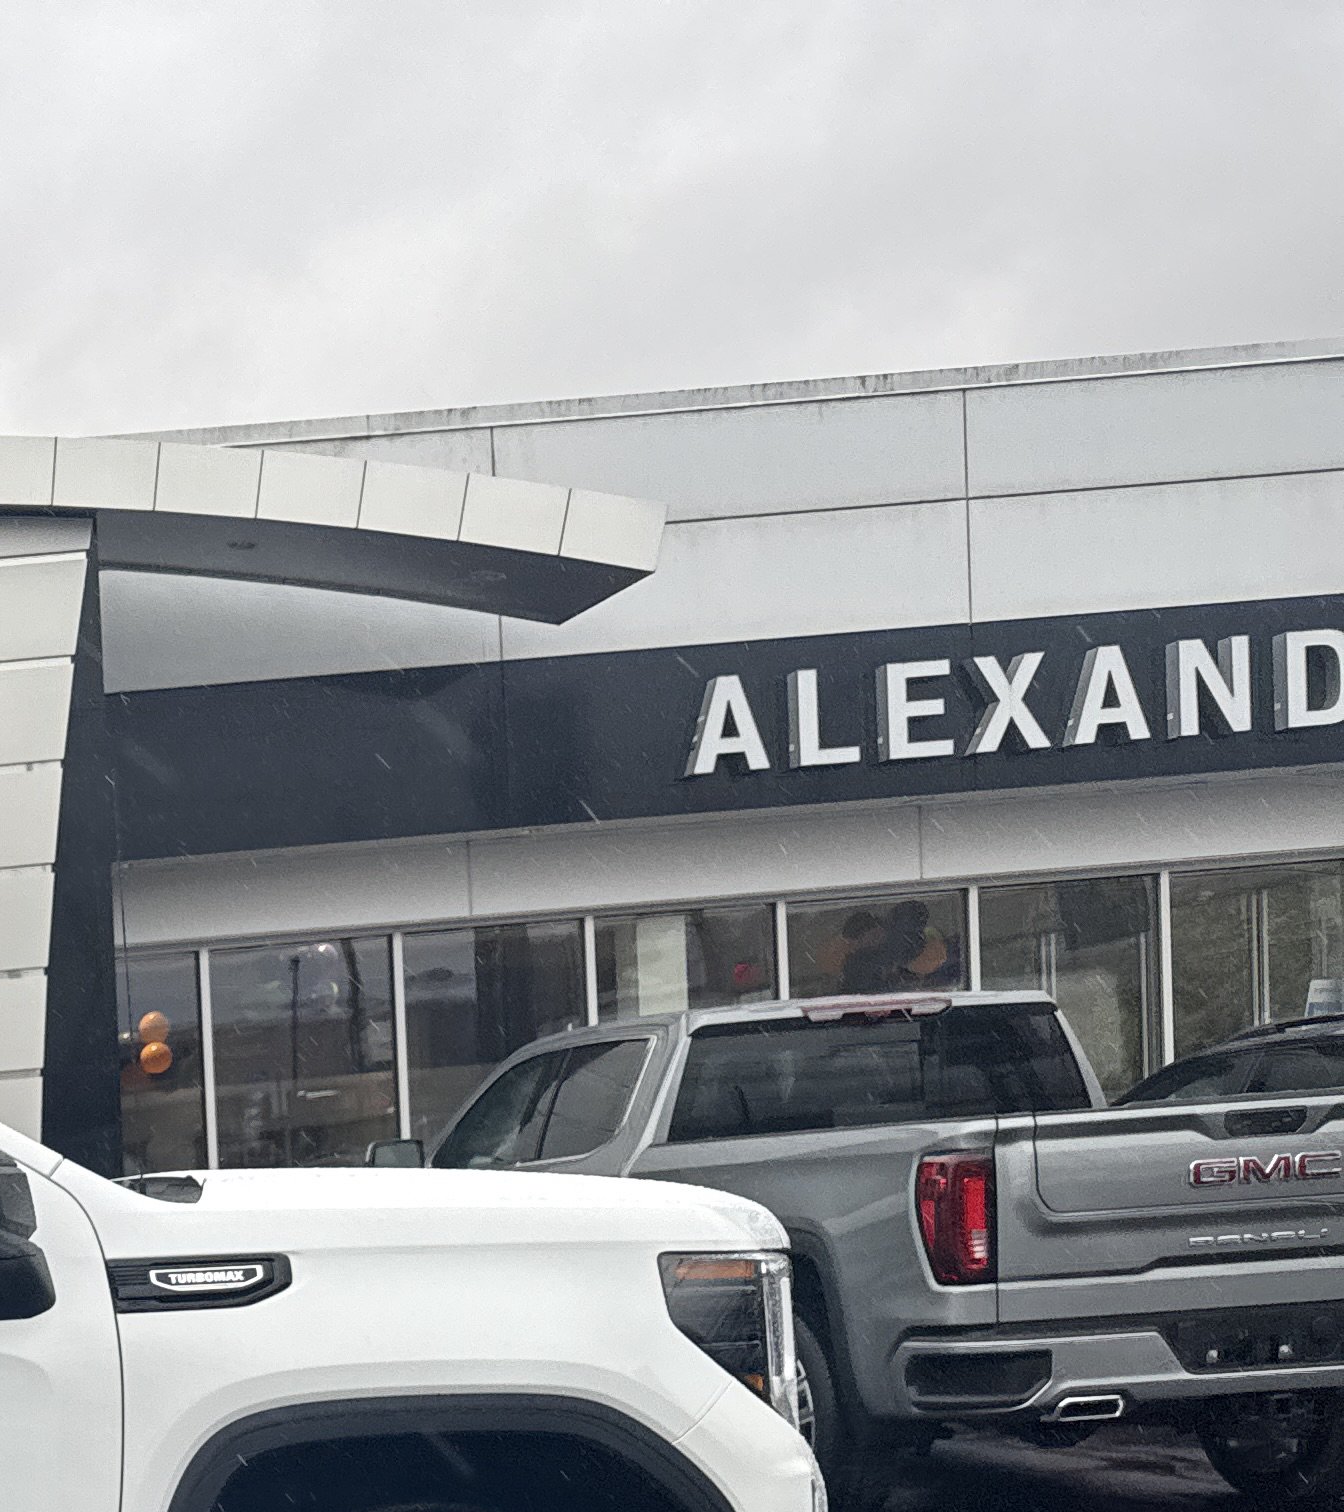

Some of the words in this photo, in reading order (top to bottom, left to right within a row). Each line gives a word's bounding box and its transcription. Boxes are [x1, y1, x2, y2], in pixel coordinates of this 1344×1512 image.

[684, 629, 1344, 777] ALEXAND
[1189, 1150, 1342, 1186] GMC
[167, 1270, 245, 1285] TURBOMAX
